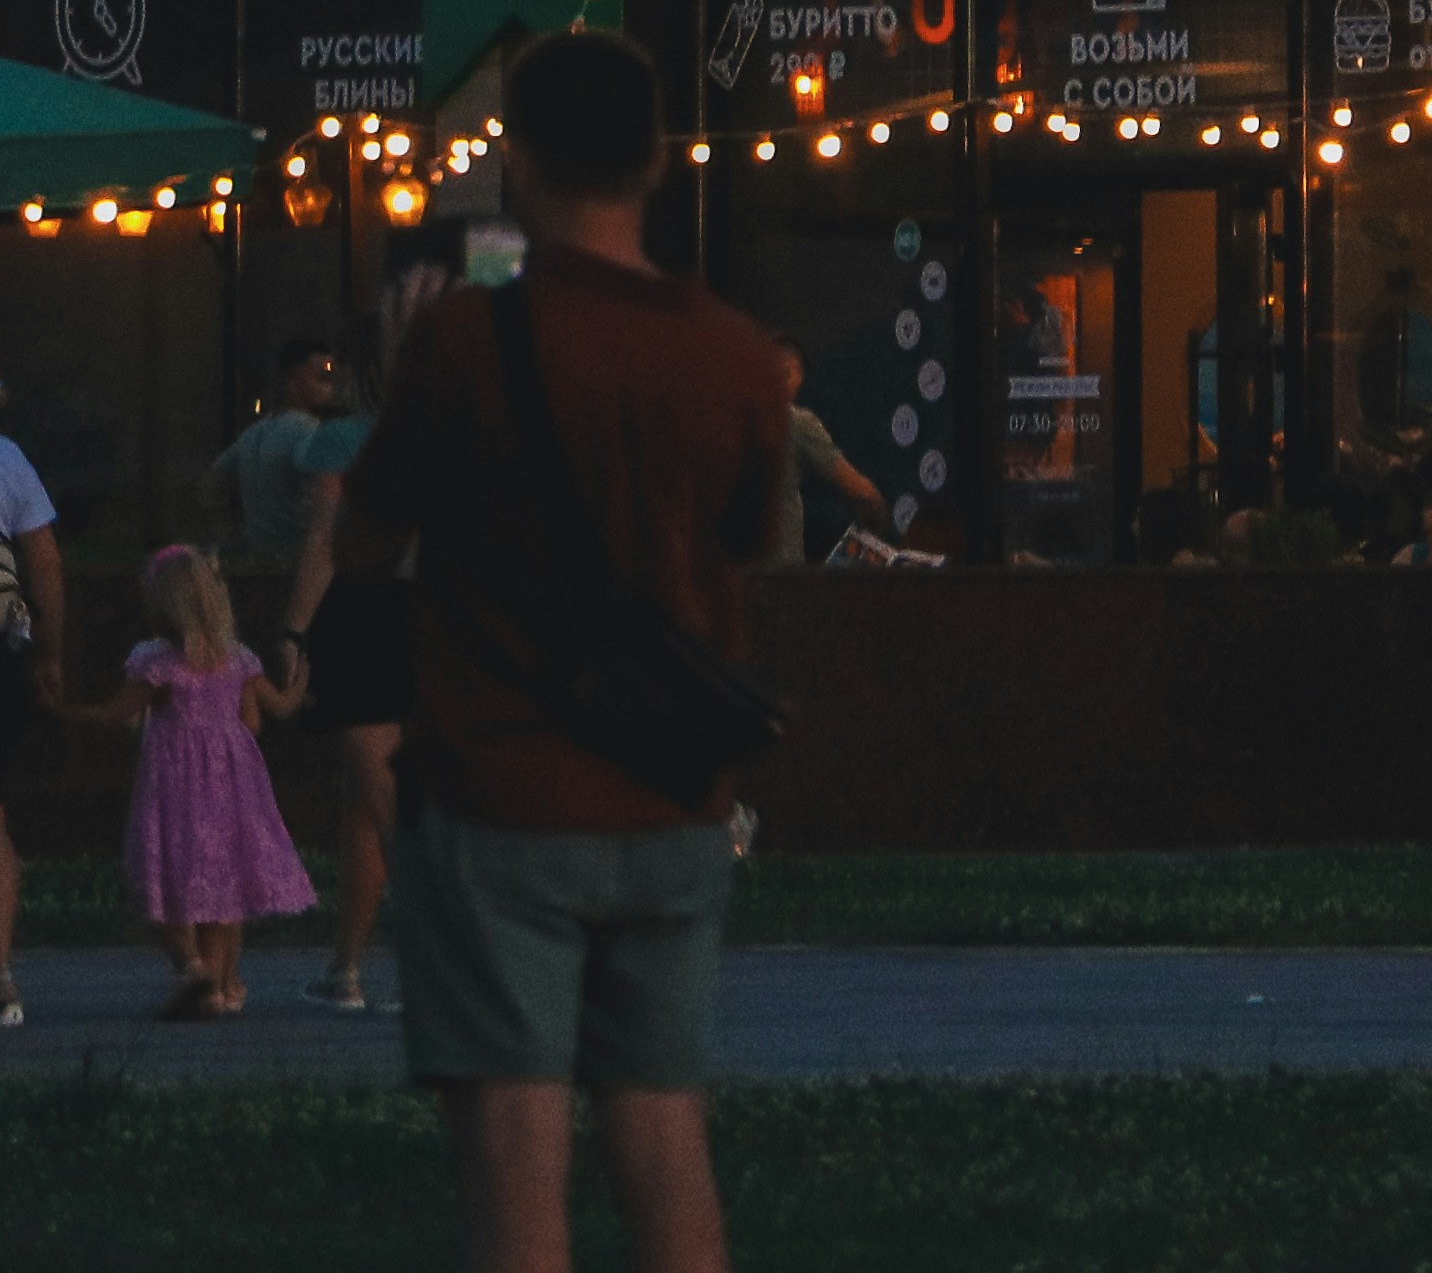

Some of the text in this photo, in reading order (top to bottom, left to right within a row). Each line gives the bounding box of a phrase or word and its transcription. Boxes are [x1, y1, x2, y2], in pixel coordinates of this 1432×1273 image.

[769, 5, 898, 40] БУРИТТО
[1071, 29, 1189, 64] ВОЗЬМИ
[315, 77, 415, 109] БЛИНЫ
[1093, 65, 1197, 110] СОБОЙ
